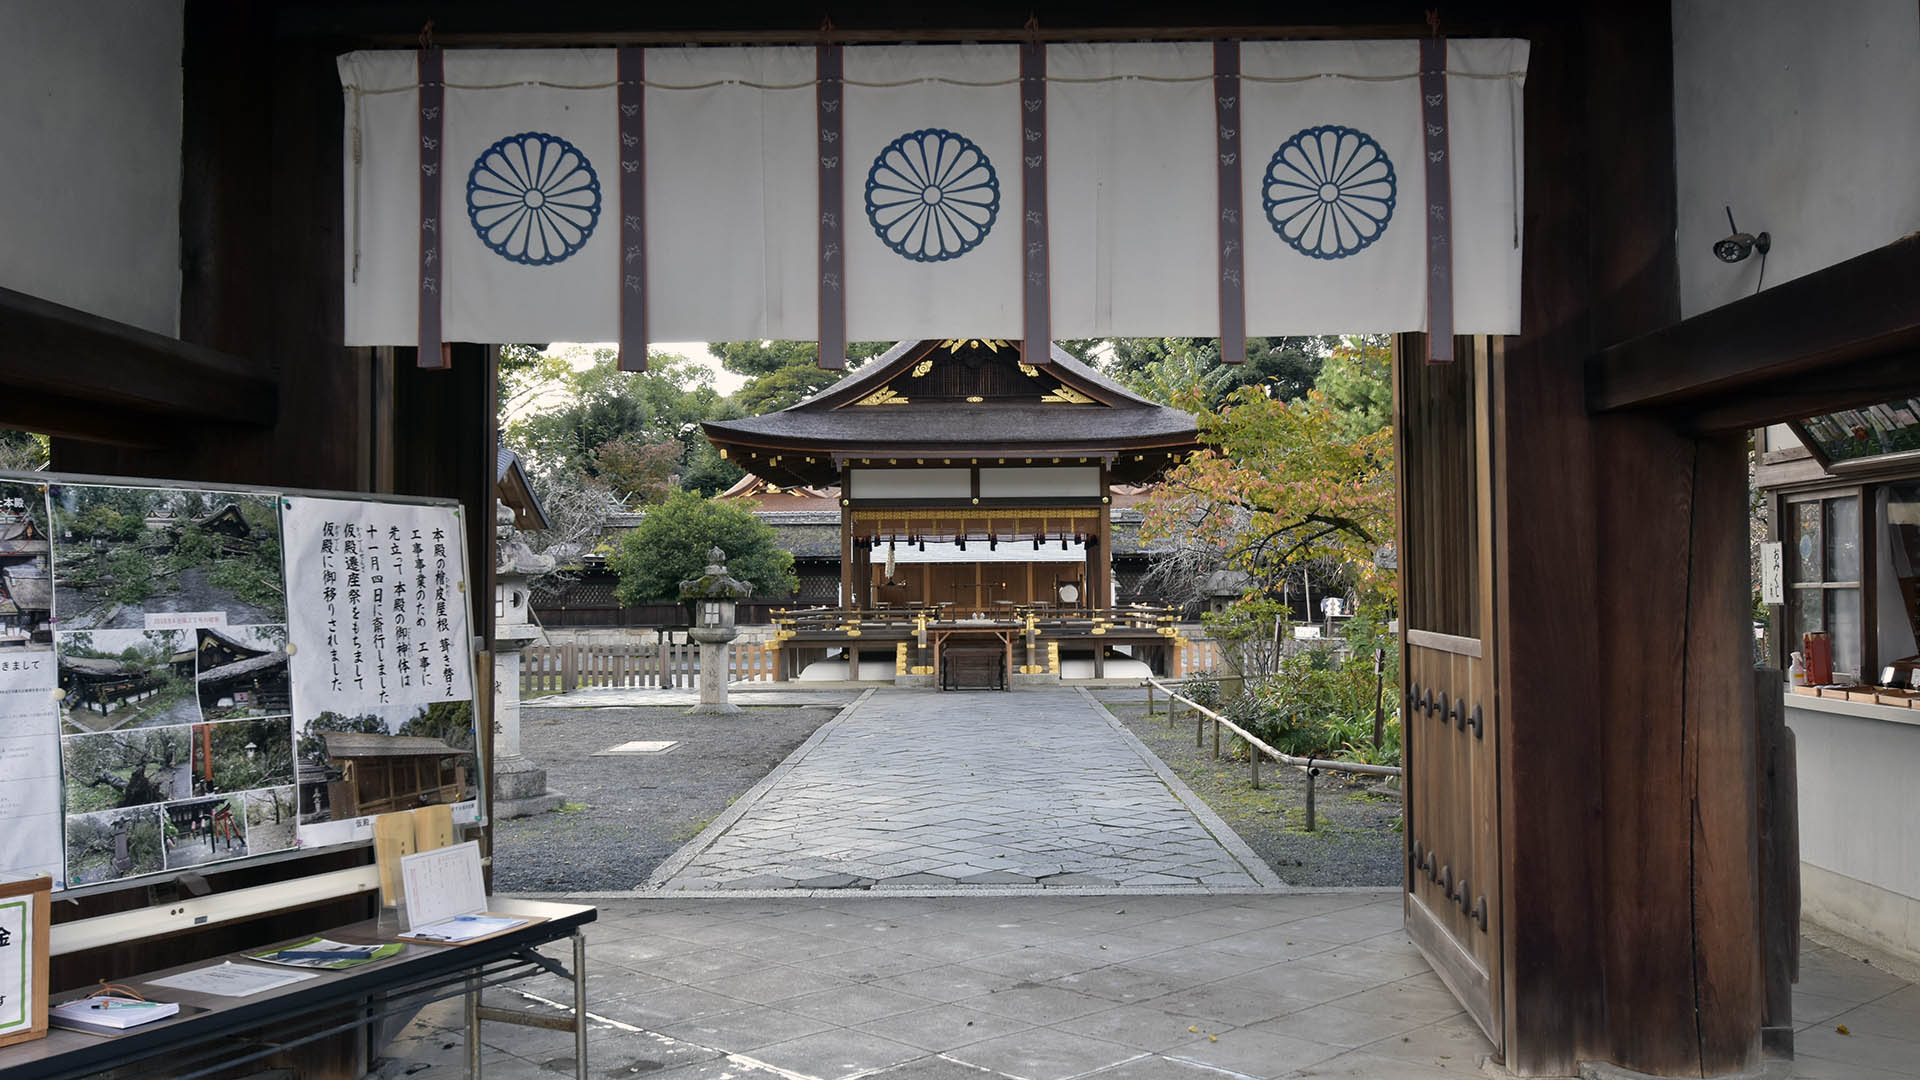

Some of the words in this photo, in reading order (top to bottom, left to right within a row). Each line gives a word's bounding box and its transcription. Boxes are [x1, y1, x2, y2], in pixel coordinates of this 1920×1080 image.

[320, 520, 342, 692] 仮殿に御移りされました
